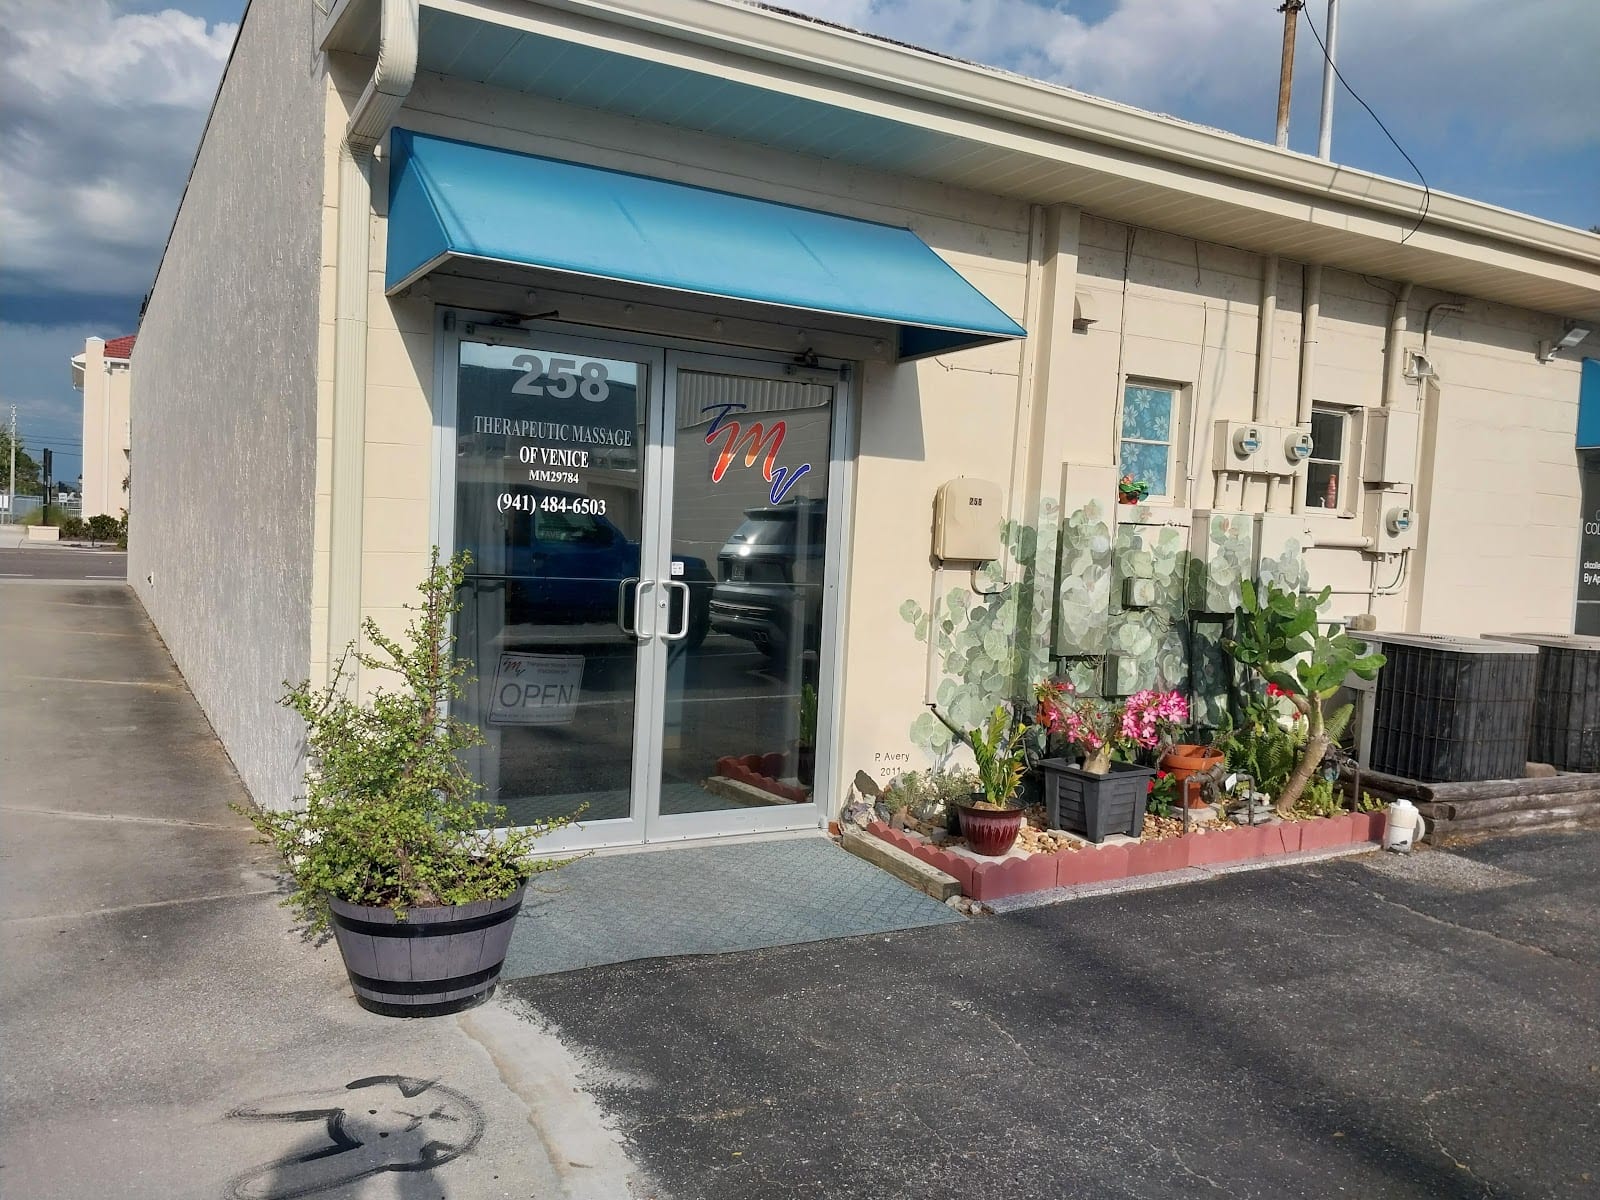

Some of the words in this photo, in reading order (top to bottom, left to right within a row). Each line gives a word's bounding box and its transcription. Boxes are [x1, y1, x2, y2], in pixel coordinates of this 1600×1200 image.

[512, 354, 609, 402] 258
[474, 416, 569, 440] THERAPEUTIC
[572, 425, 632, 446] MASSAGE
[520, 446, 538, 464] OF
[541, 448, 589, 468] VENICE
[529, 470, 579, 483] MM29784
[497, 493, 536, 514] (941)
[540, 496, 606, 515] 484-6503
[1583, 573, 1593, 585] By
[500, 683, 574, 708] OPEN
[884, 752, 910, 762] Avery
